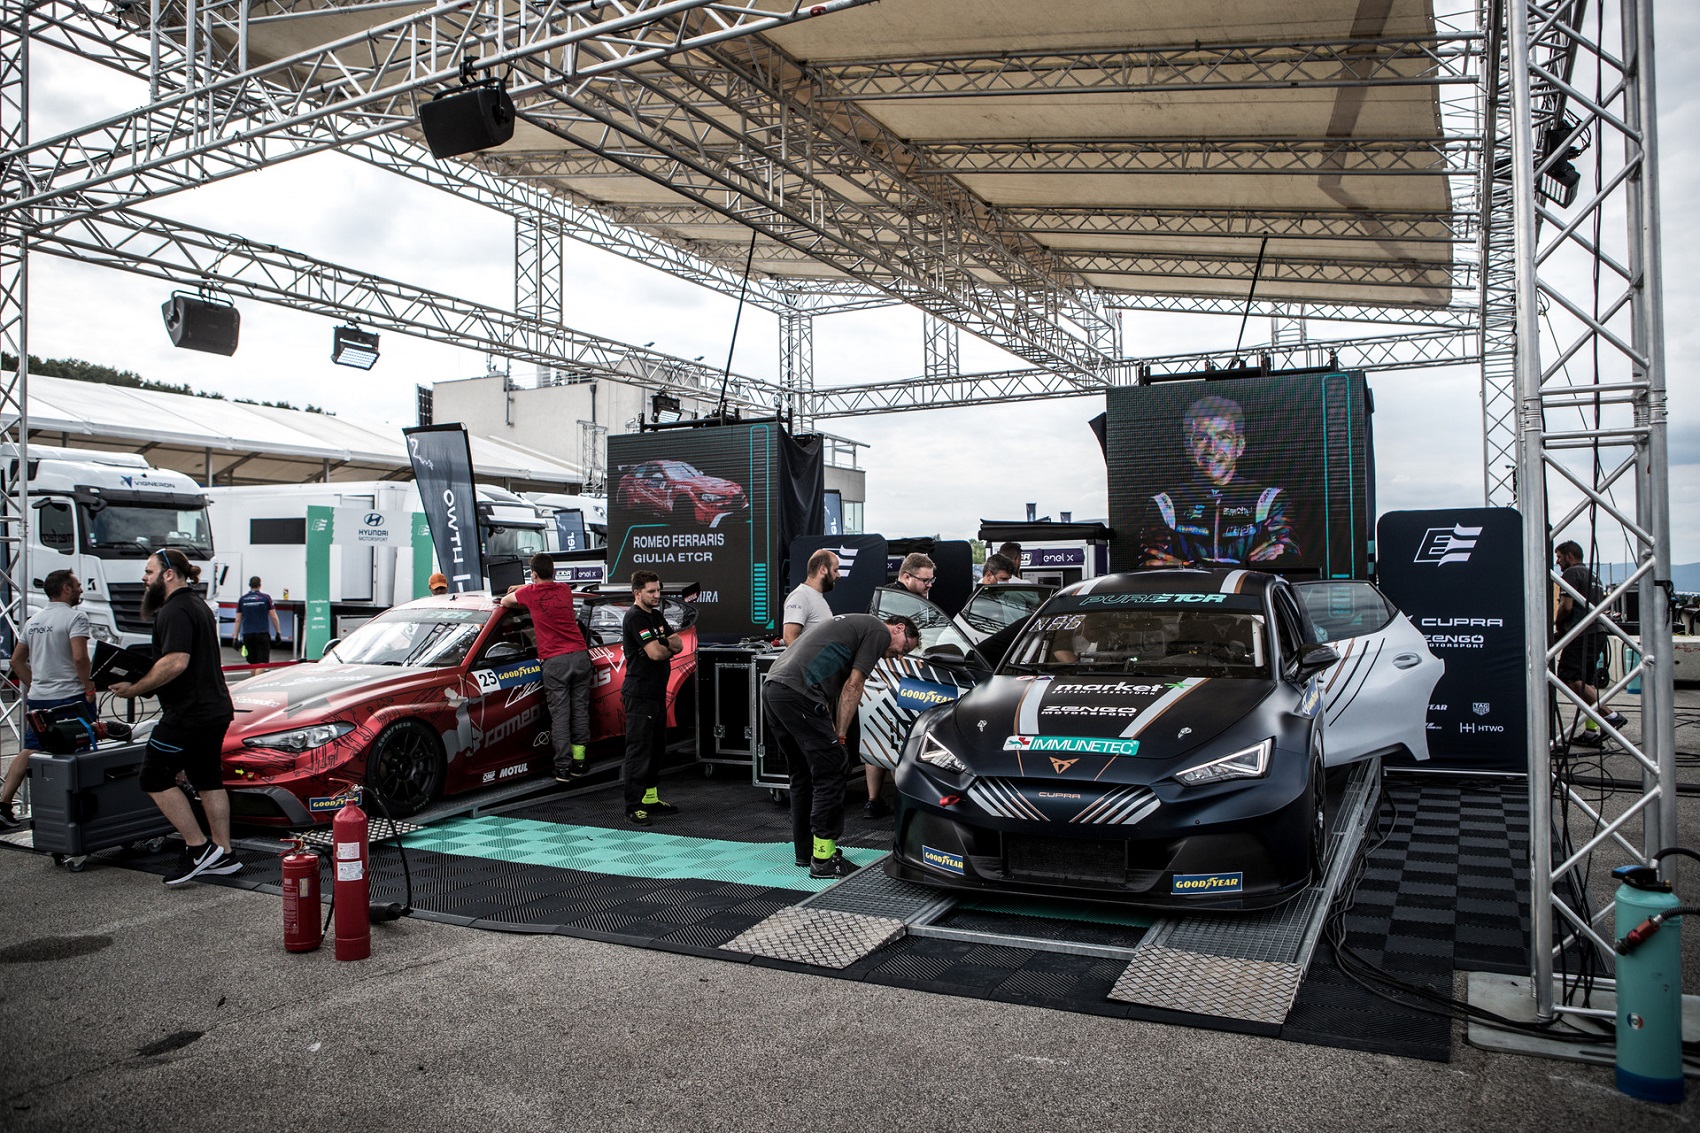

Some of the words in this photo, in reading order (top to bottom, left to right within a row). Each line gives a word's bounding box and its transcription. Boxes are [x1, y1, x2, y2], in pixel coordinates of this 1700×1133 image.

[133, 479, 176, 489] VIGNERON
[358, 529, 389, 537] HYUNDAI
[633, 535, 671, 549] ROMEO
[672, 533, 725, 547] FERRARIS
[633, 553, 675, 563] GIULIA
[678, 551, 713, 562] ETCR
[1043, 553, 1065, 563] enel
[1421, 617, 1504, 628] CUPRA
[498, 665, 541, 681] GOODYEAR
[479, 671, 498, 687] 25
[1054, 681, 1163, 692] market
[1478, 725, 1504, 733] HTWO
[499, 762, 528, 778] MOTUL
[1038, 791, 1081, 800] CUPRA
[924, 851, 963, 869] GOODYEAR
[1175, 877, 1239, 890] GOODYEAR
